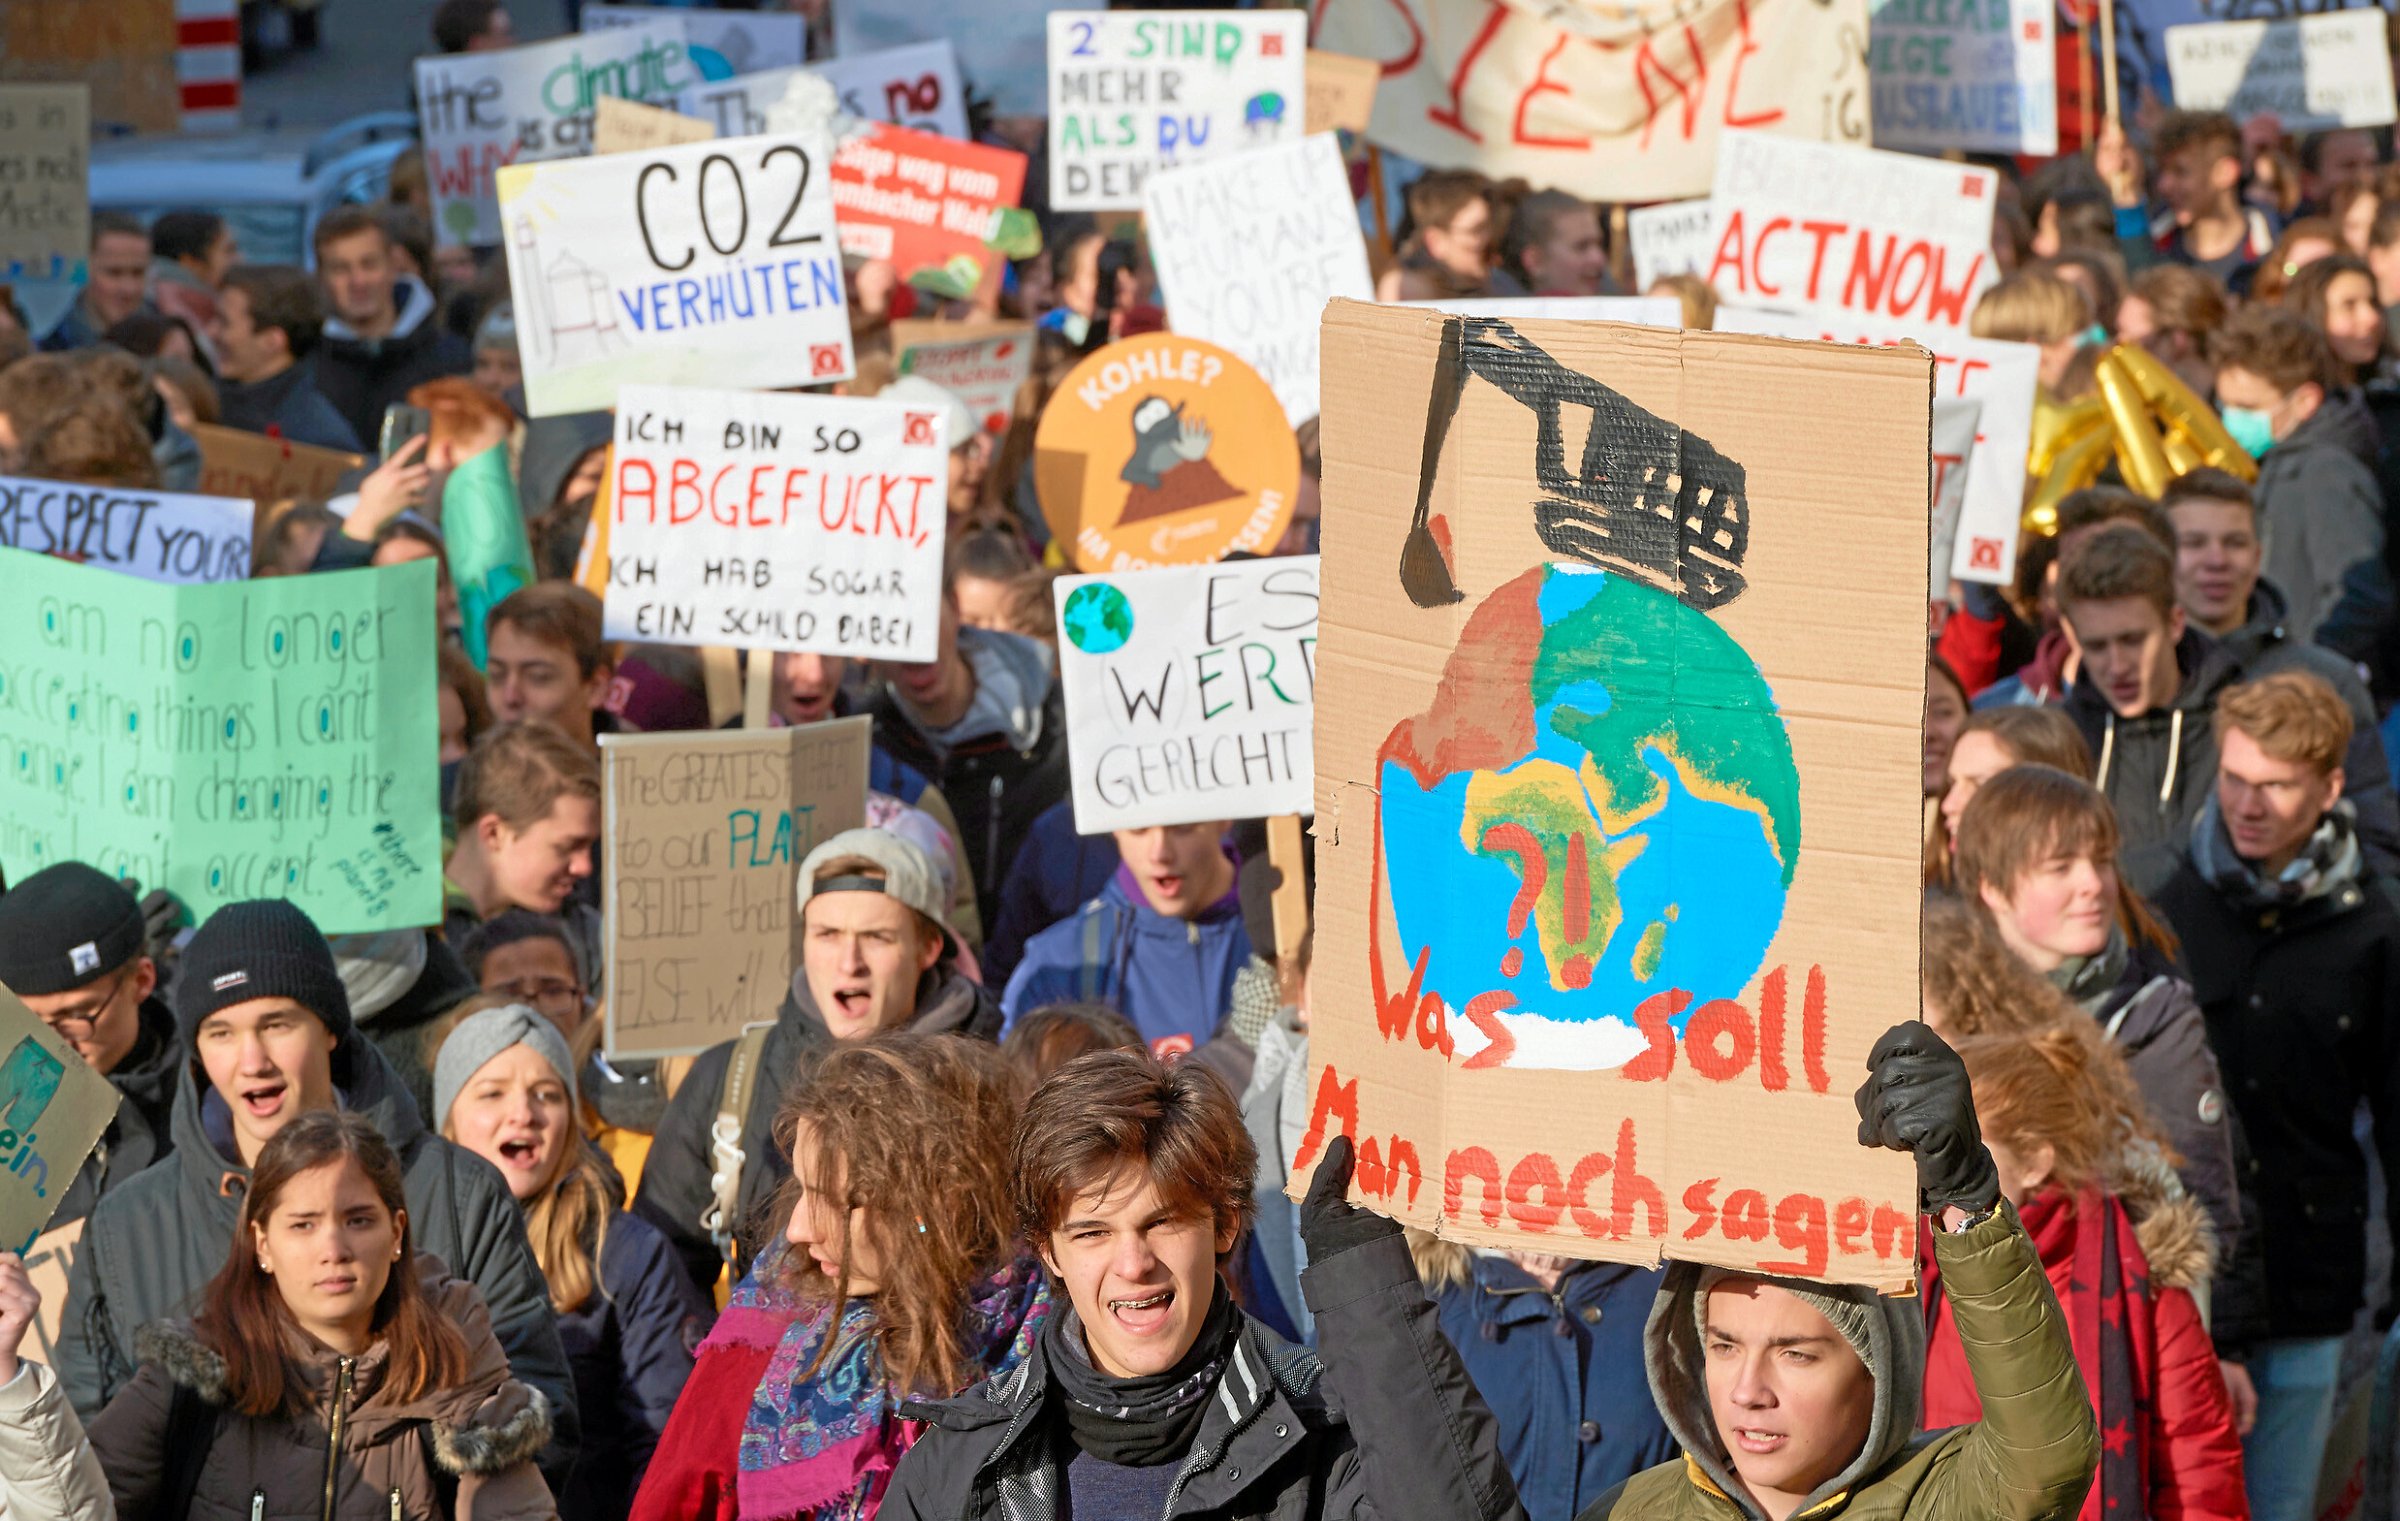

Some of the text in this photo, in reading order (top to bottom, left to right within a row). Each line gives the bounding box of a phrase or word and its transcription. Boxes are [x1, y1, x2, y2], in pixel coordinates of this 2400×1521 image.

[1128, 20, 1243, 67] SIND
[424, 69, 507, 134] the
[884, 69, 942, 118] no
[1061, 70, 1184, 104] MEHR
[1062, 115, 1211, 154] ALS DU
[429, 137, 526, 198] WHY
[1066, 161, 1181, 198] DEN
[636, 144, 823, 272] CO2
[1150, 162, 1276, 241] WAKE
[1168, 190, 1356, 289] HUMANS
[618, 256, 842, 333] VERHÜTEN
[1077, 348, 1223, 412] KOHLE?
[627, 412, 862, 454] ICH BIN SO
[618, 458, 934, 549] ABGEFUCKT,
[155, 523, 250, 583] YOUR
[606, 557, 906, 599] ICH HAB SOGAR
[635, 603, 913, 647] EIN SCHILD DABEI
[1205, 568, 1319, 646] ES
[38, 594, 397, 691] am no longer
[154, 684, 257, 779] things
[272, 677, 282, 748] I
[121, 769, 175, 822] am
[195, 759, 333, 843] changing
[347, 752, 396, 817] the
[1095, 728, 1300, 810] GERECHT
[204, 841, 324, 898] accept.
[618, 819, 653, 870] to
[660, 827, 721, 872] our
[723, 870, 787, 936] that
[706, 947, 767, 1026] will
[1368, 930, 1832, 1095] Was soll
[1292, 1064, 1914, 1277] Man noch sagen
